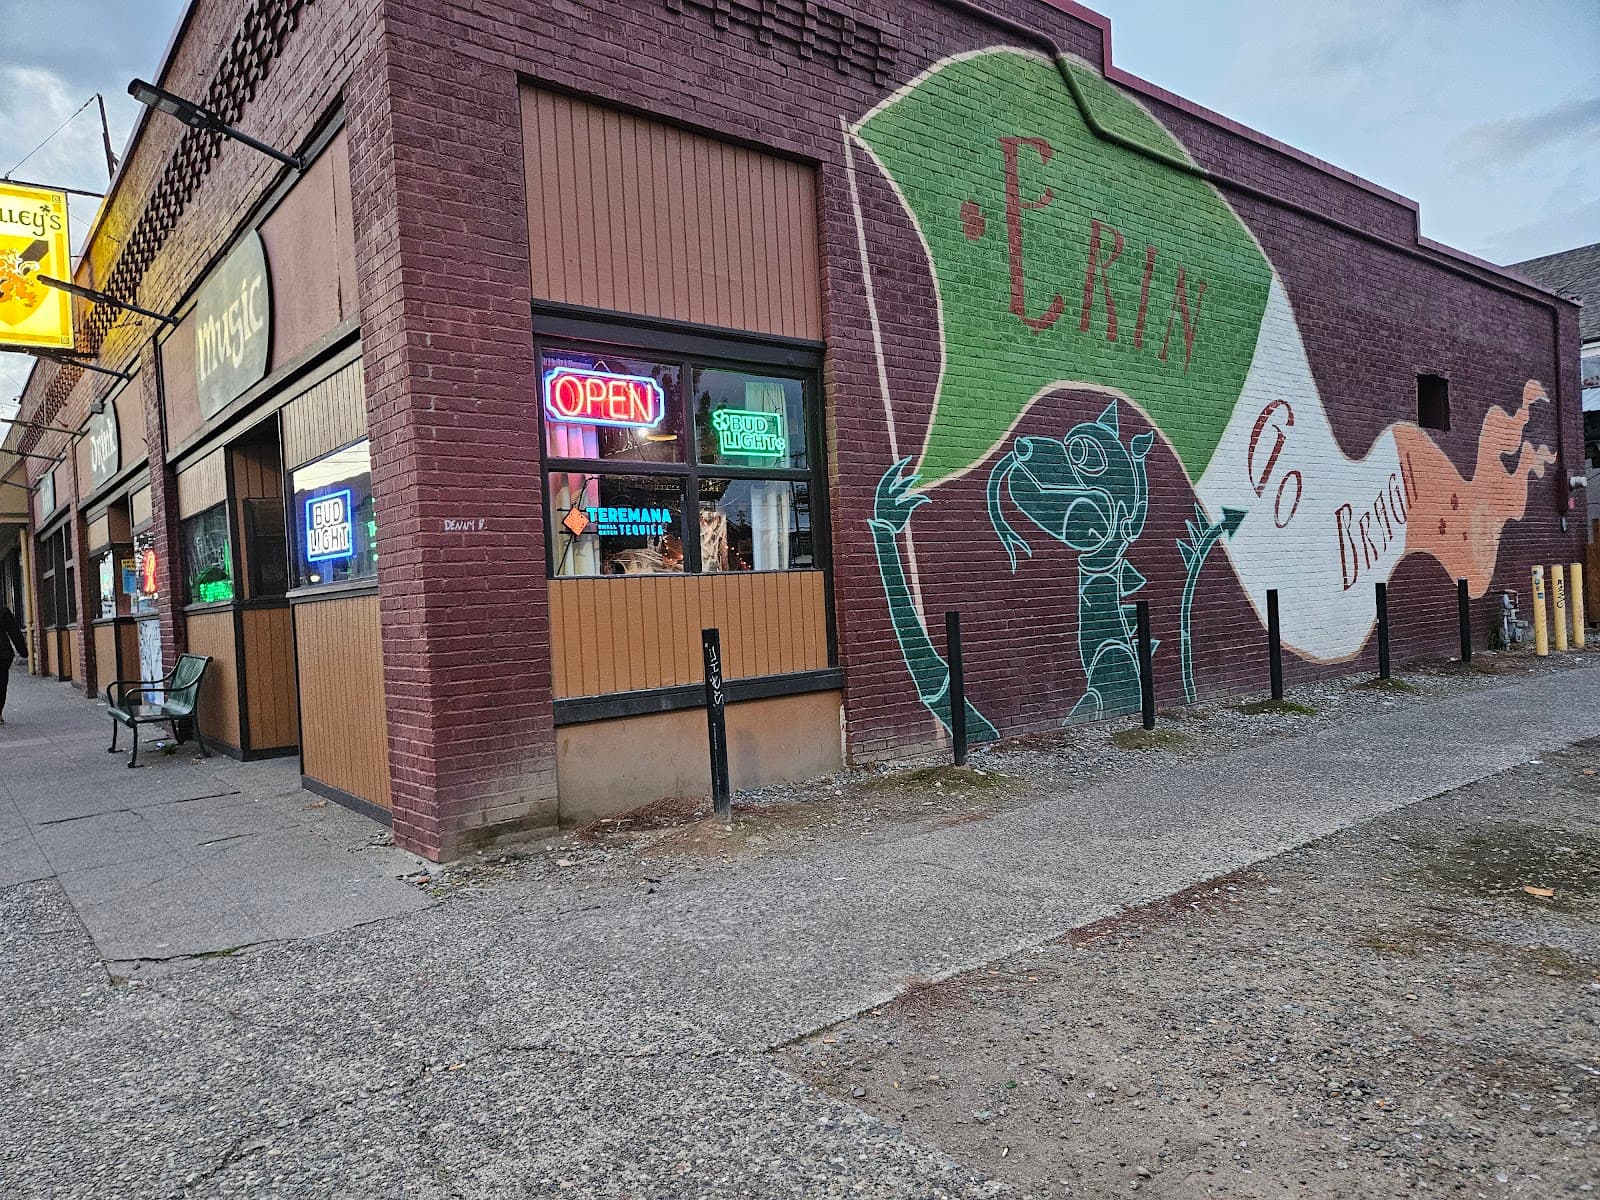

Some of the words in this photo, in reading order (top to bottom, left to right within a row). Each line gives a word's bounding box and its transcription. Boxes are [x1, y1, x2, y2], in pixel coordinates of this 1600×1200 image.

[999, 136, 1208, 374] ERIN
[555, 375, 653, 423] OPEN
[730, 415, 769, 434] BUD
[723, 430, 777, 451] LIGHT
[313, 497, 344, 529] BUD
[444, 519, 475, 531] DENNY
[586, 507, 672, 523] TEREMANA
[1334, 451, 1418, 591] BRAGH
[309, 523, 350, 556] LIGHT
[618, 524, 665, 536] TEQUILA
